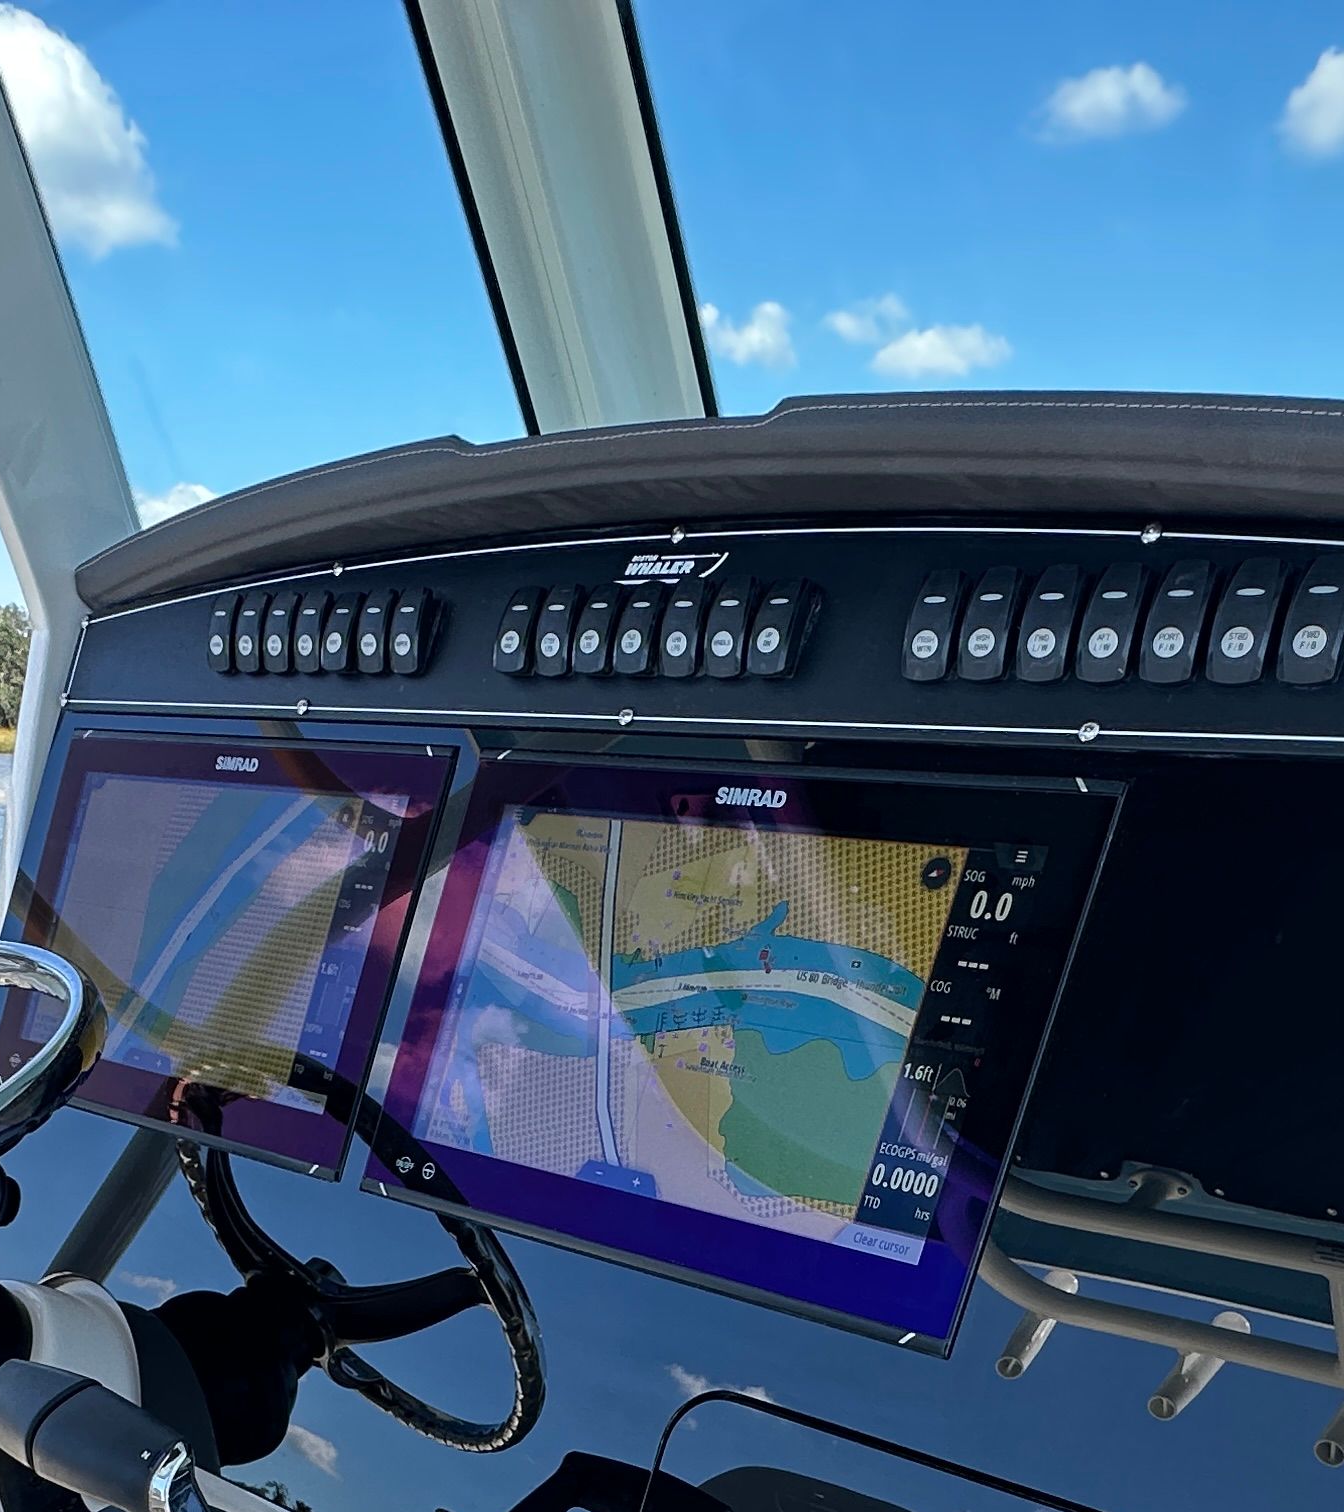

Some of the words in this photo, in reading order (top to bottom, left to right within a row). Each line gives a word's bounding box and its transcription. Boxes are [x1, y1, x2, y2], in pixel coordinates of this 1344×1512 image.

[624, 560, 695, 576] WHALER
[1158, 632, 1180, 641] PORT
[215, 755, 259, 772] SIMRAD
[715, 786, 787, 808] SIMRAD
[363, 829, 389, 853] 0.0
[964, 869, 986, 883] SOG
[1011, 876, 1035, 889] mph
[969, 890, 1013, 922] 0.0
[946, 924, 979, 940] STRUC
[1009, 931, 1019, 945] ft
[821, 973, 849, 990] Bridge
[930, 980, 952, 994] COG
[904, 1063, 934, 1083] 1.6ft
[879, 1142, 917, 1160] ECOGPS
[916, 1151, 948, 1169] mi/gal
[871, 1163, 939, 1198] 0.0000
[863, 1194, 881, 1210] TTD
[914, 1207, 930, 1222] hrs
[853, 1231, 877, 1246] Clear
[879, 1240, 910, 1256] cursor
